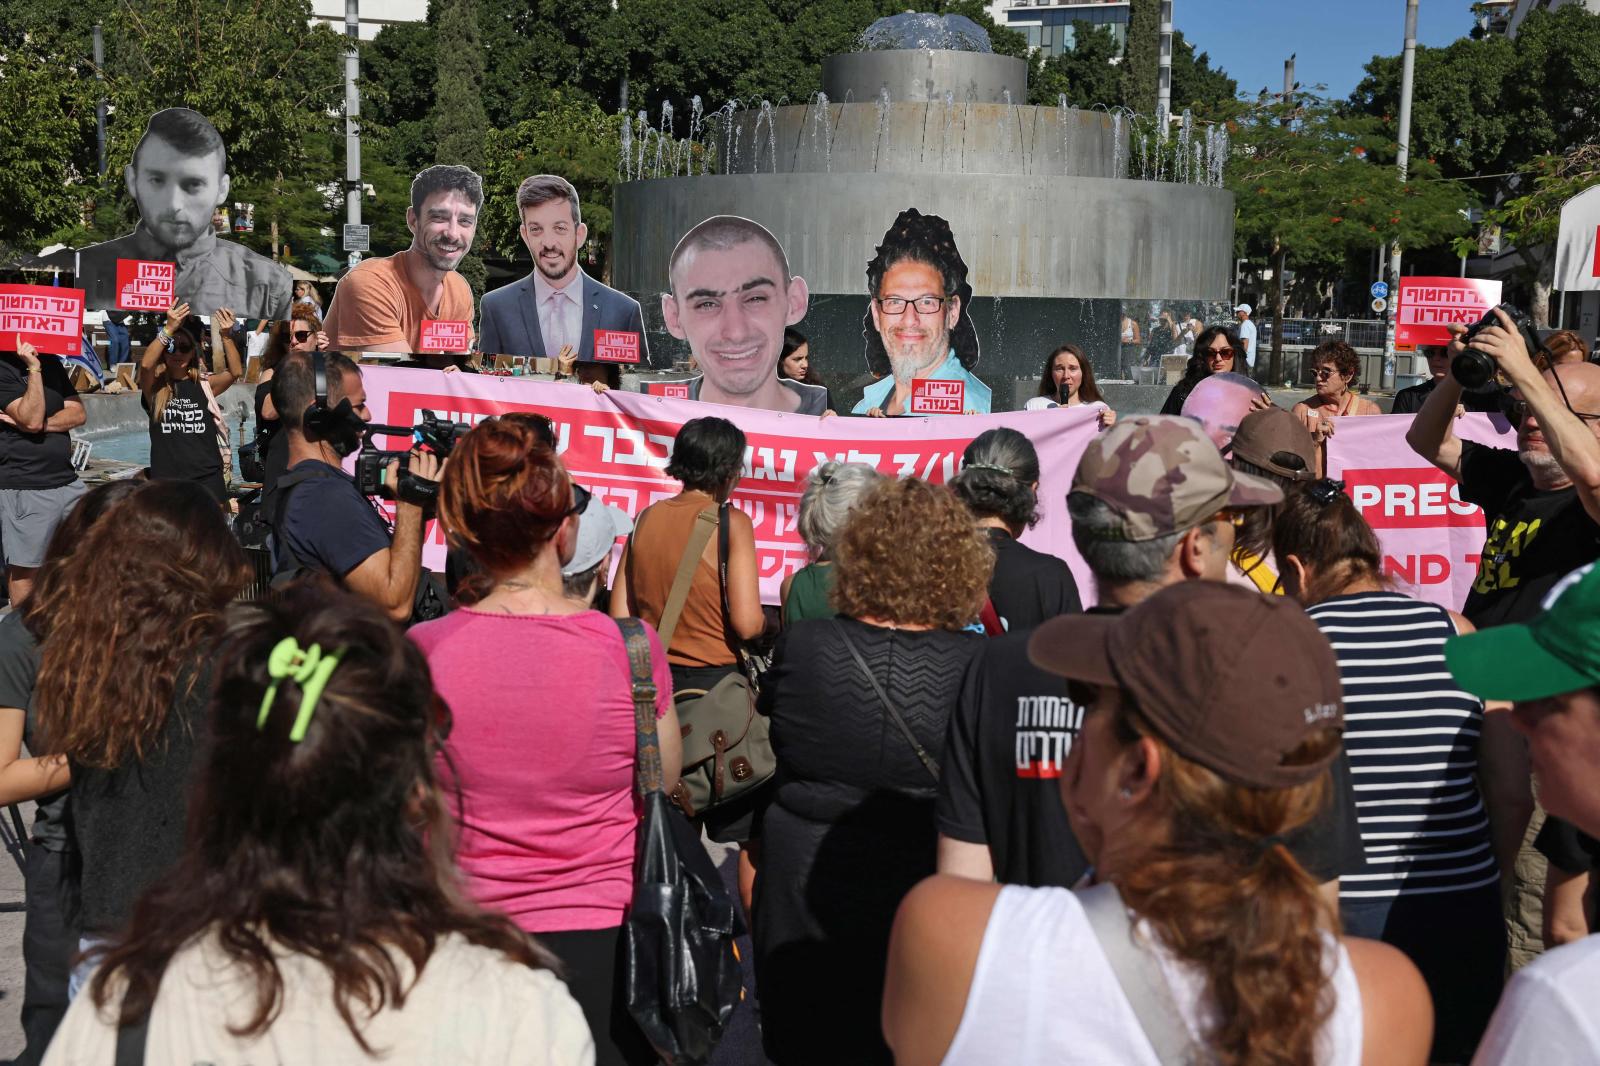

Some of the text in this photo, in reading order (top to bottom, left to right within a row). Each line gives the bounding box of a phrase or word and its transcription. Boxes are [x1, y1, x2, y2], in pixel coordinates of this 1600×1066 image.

[142, 264, 171, 278] מתן
[136, 279, 171, 292] עדיין
[126, 295, 170, 306] בעזה.
[1406, 288, 1465, 303] החטוף
[50, 299, 75, 313] עד
[1413, 308, 1482, 323] האחרון
[2, 315, 65, 332] האחרון
[435, 323, 465, 335] עדיין
[427, 337, 464, 348] בעזה.
[607, 333, 636, 345] עדיין
[600, 347, 637, 359] בעזה.
[927, 383, 960, 396] עדיין
[918, 398, 960, 410] בעזה.
[1383, 554, 1450, 584] ND
